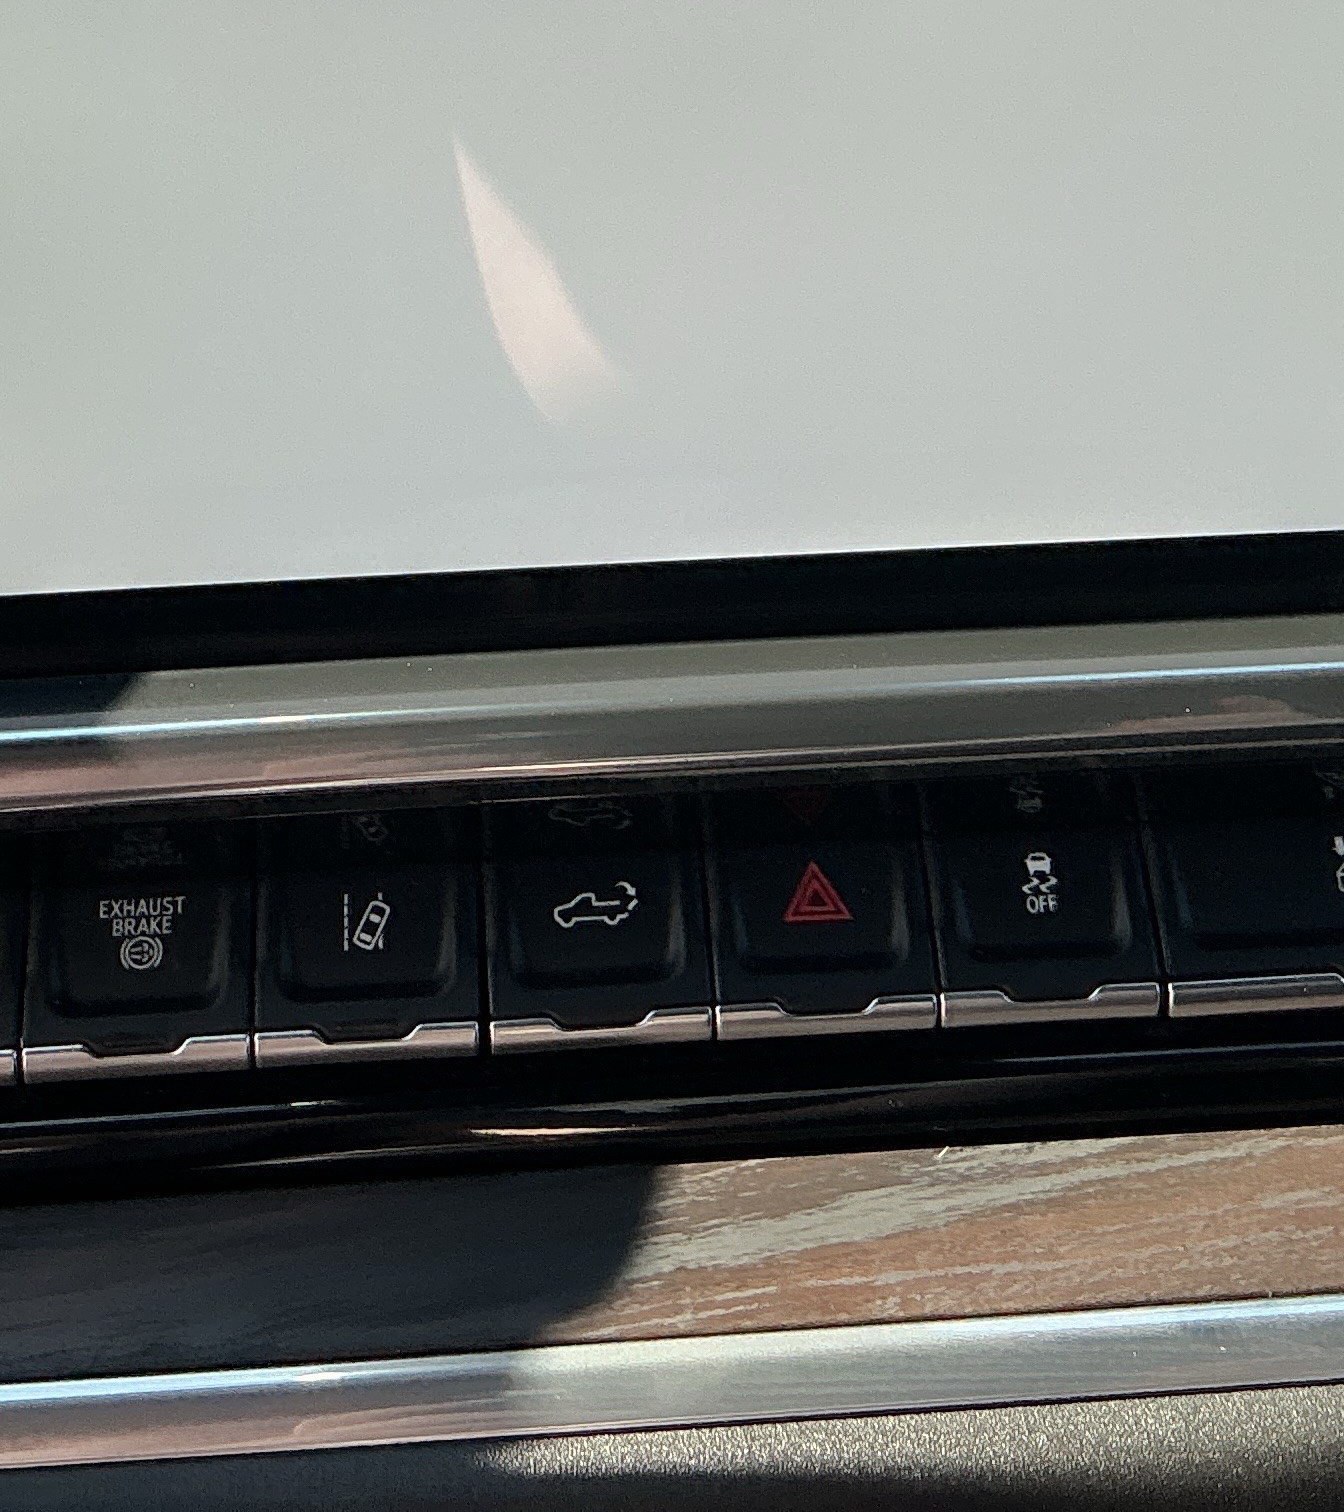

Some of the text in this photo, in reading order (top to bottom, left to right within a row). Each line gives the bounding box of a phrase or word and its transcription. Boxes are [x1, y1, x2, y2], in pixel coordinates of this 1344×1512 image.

[99, 895, 187, 919] EXHAUST
[1025, 893, 1059, 914] OFF
[111, 915, 173, 937] BRAKE
